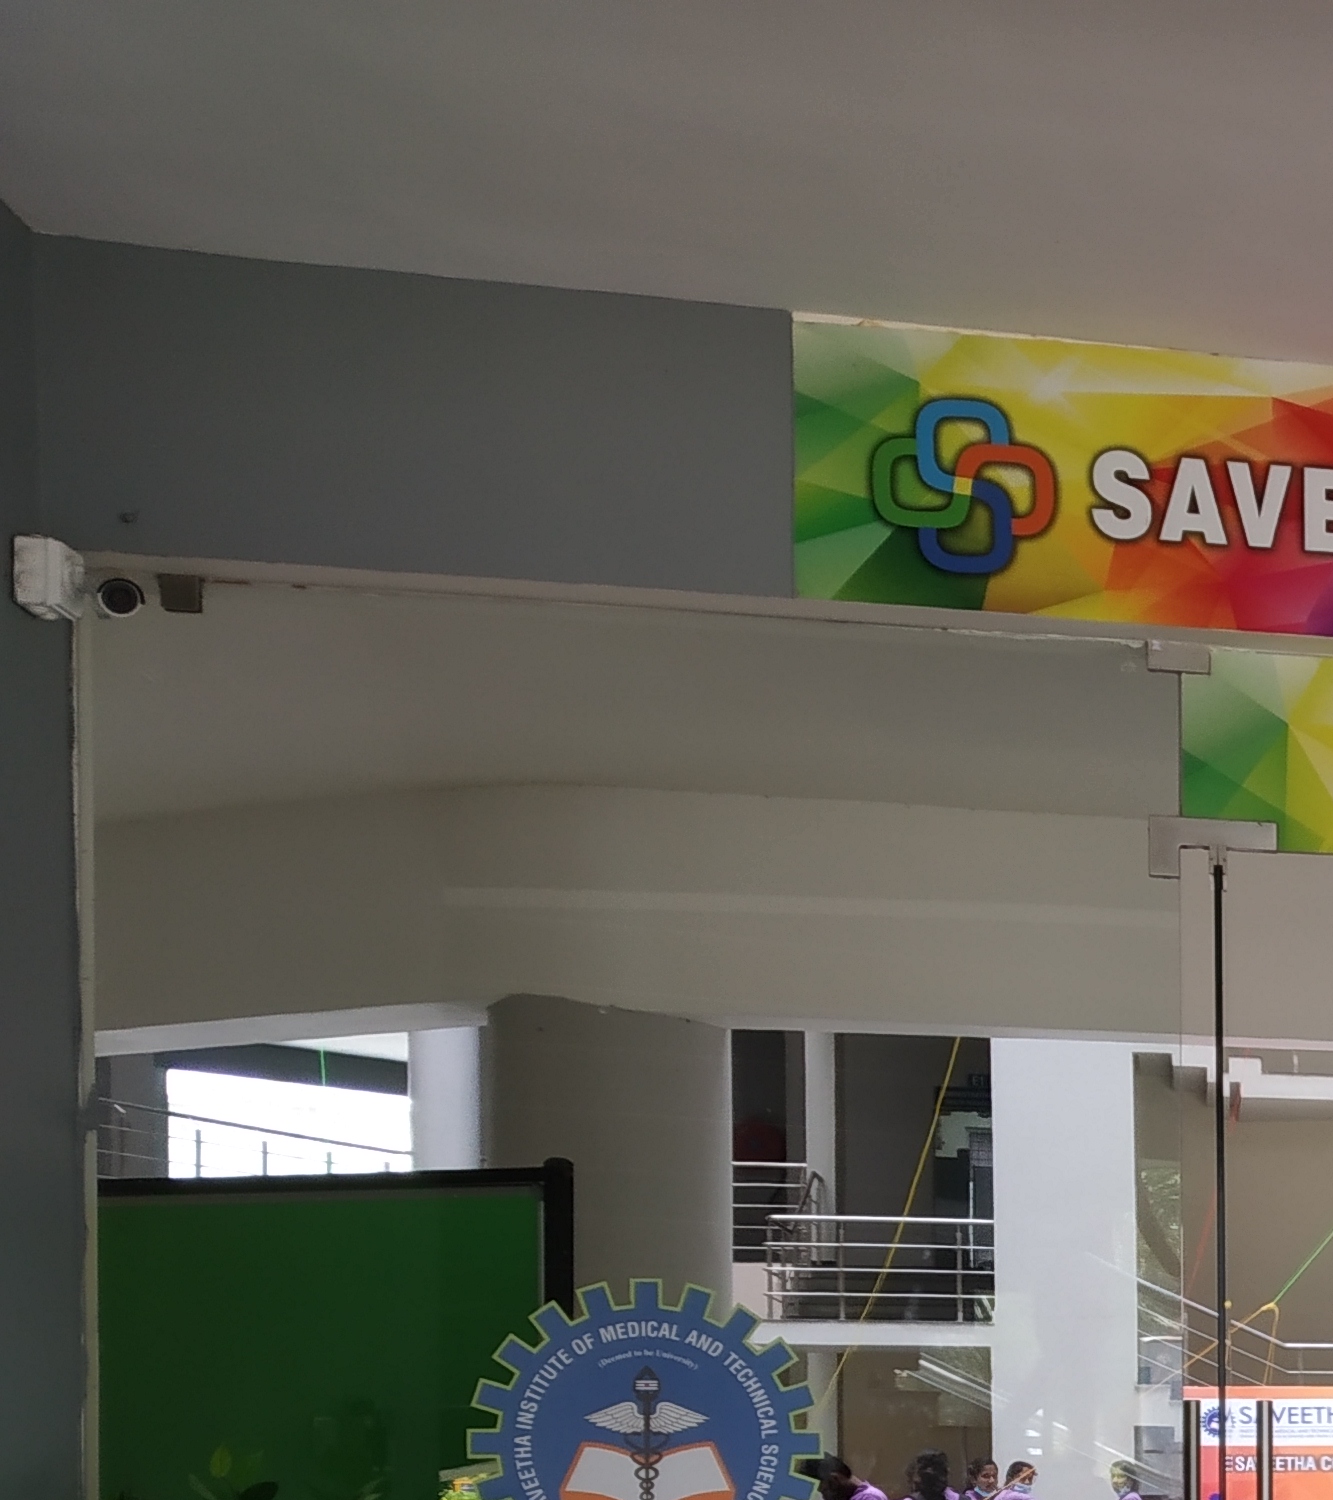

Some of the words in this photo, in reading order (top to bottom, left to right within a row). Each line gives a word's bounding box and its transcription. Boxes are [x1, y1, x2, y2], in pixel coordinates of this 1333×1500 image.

[516, 1349, 574, 1429] INSTITUTE
[571, 1333, 595, 1356] OF
[600, 1321, 681, 1342] MEDICAL
[685, 1329, 724, 1357] AND
[723, 1351, 779, 1439] TECHNICAL
